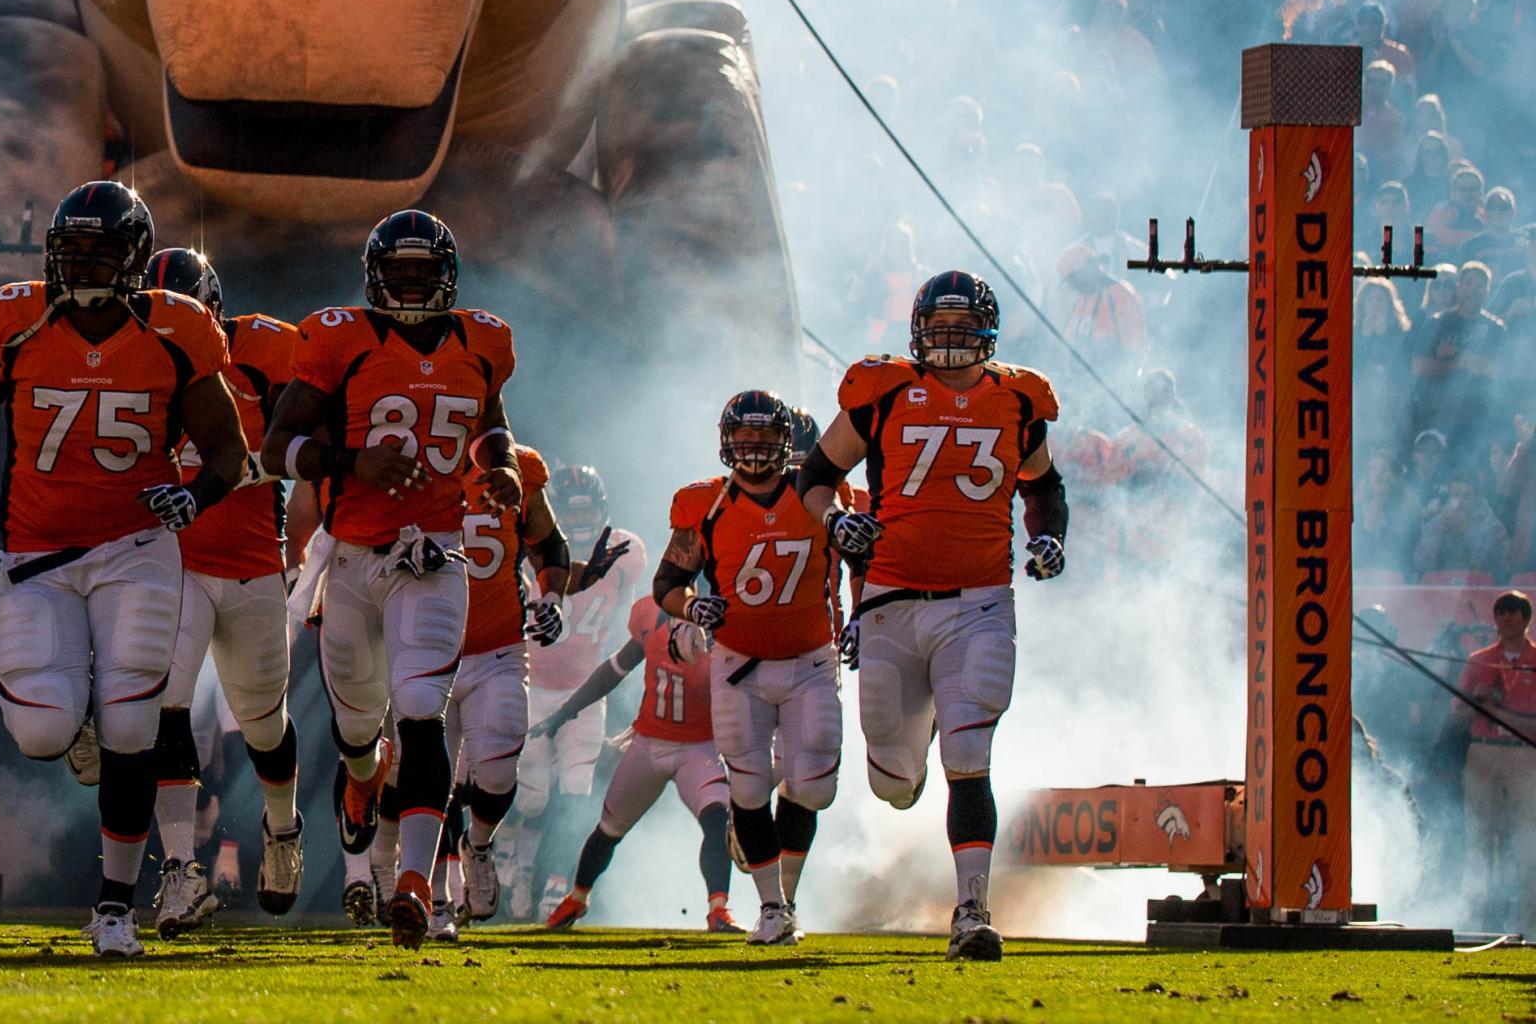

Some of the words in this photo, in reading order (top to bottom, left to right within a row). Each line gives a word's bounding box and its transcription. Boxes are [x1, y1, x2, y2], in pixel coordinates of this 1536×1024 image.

[70, 376, 113, 385] BRONCOS
[1252, 205, 1267, 479] DENVER
[1295, 212, 1330, 488] DENVER
[33, 387, 152, 472] 75
[365, 394, 479, 475] 85
[908, 387, 928, 403] C
[900, 425, 1006, 502] 73
[735, 538, 813, 607] 67
[655, 667, 685, 723] 11
[1251, 499, 1267, 824] BRONCOS
[1295, 510, 1329, 837] BRONCOS
